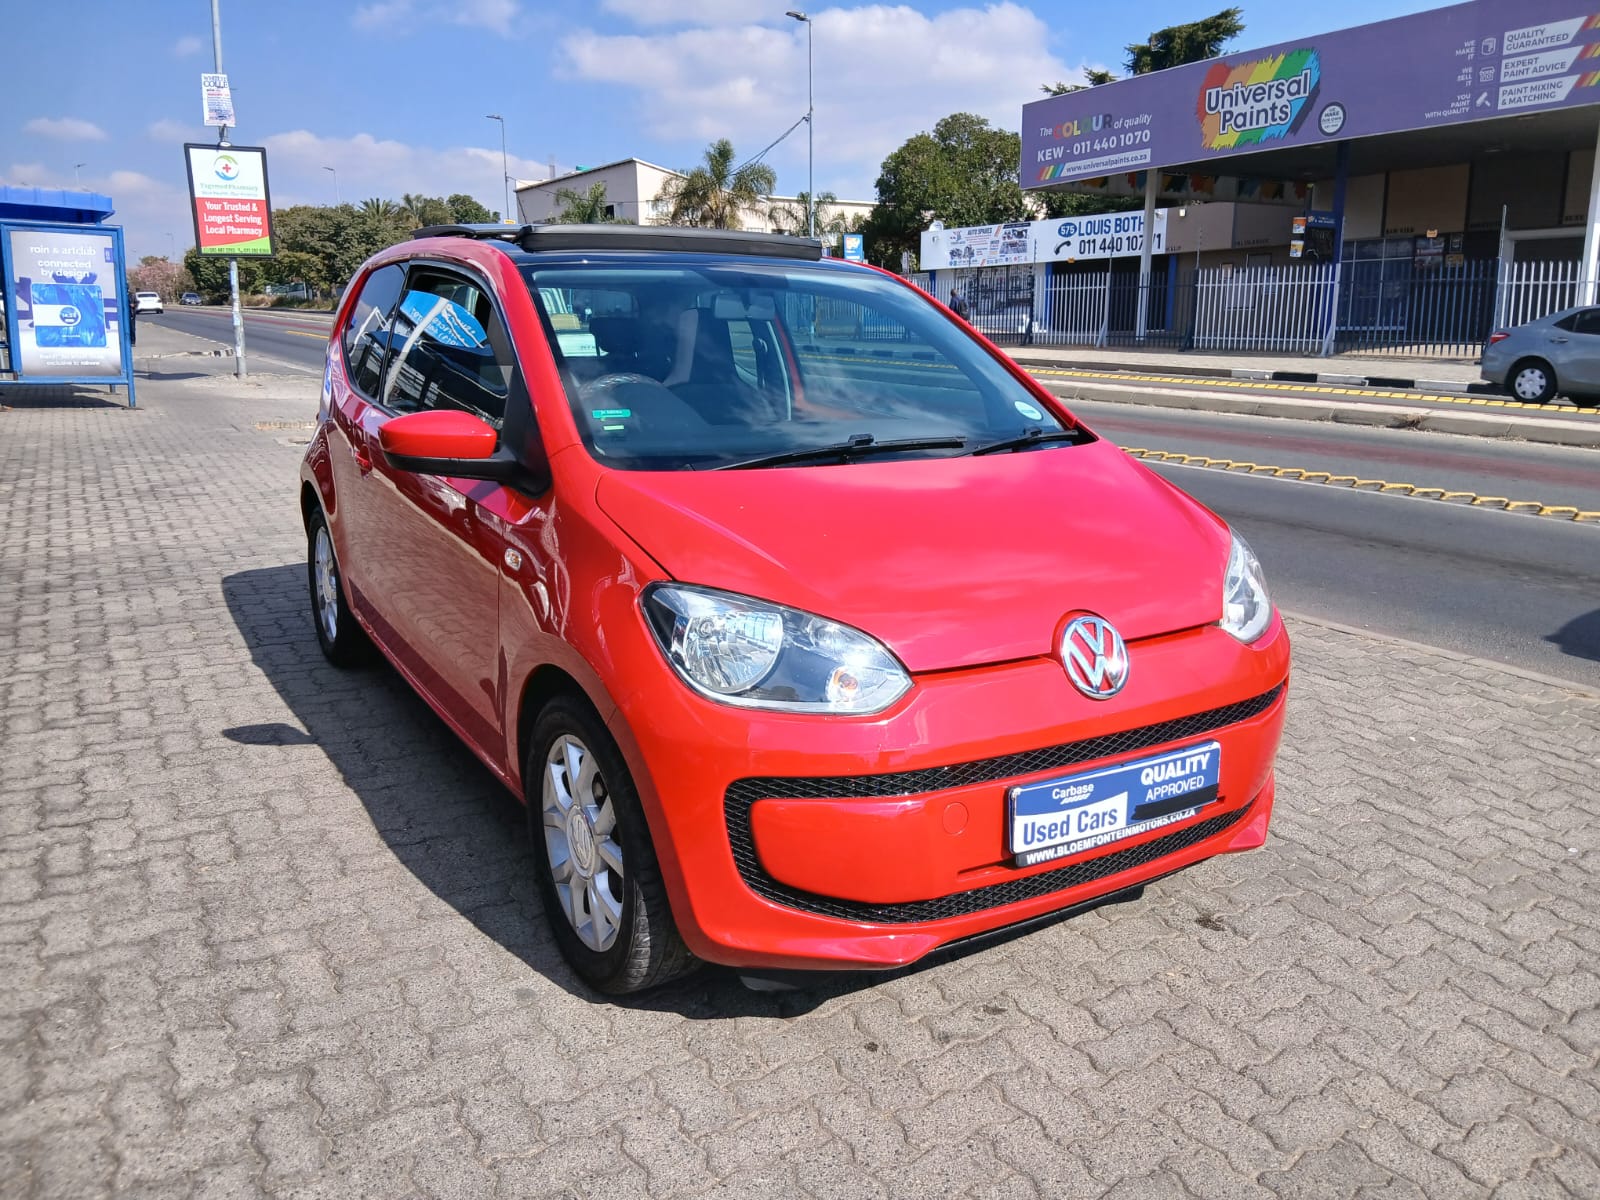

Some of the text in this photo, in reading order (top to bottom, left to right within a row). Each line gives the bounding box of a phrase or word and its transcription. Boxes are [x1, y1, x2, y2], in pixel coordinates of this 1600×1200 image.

[1506, 33, 1569, 51] GUARANTEED
[1507, 28, 1546, 42] QUALITY
[1456, 47, 1475, 56] MAKE
[1504, 57, 1540, 70] EXPERT
[1504, 61, 1566, 79] PAINT ADVICE
[1457, 74, 1472, 82] SELL
[1206, 70, 1310, 113] Universal
[1502, 81, 1563, 96] PAINT MIXING
[1450, 100, 1471, 108] PAINT
[1508, 91, 1556, 105] MATCHING
[1220, 101, 1290, 133] Paints
[1442, 107, 1470, 117] QUALITY
[1040, 114, 1152, 140] The COLOUR of quality
[1037, 145, 1064, 162] KEW
[1073, 141, 1090, 155] 011
[1094, 136, 1116, 151] 440
[1120, 130, 1151, 146] 1070
[1066, 153, 1147, 173] www.universalpaints.co.za
[205, 201, 258, 212] Your Trusted &
[204, 214, 262, 225] Longest Serving
[1060, 216, 1145, 236] 575 LOUIS BOTH
[206, 225, 262, 236] Local Pharmacy
[62, 246, 96, 256] artclub
[1079, 237, 1096, 255] 011
[1099, 235, 1122, 254] 440
[38, 260, 91, 269] connected
[41, 268, 90, 279] by design
[1140, 753, 1210, 786] QUALITY
[1052, 783, 1094, 800] Carbase
[1146, 776, 1204, 802] APPROVED
[1023, 808, 1118, 846] Used Cars
[1026, 808, 1196, 864] WWW.BLOEMFONTEINMOTORS.CO.ZA
